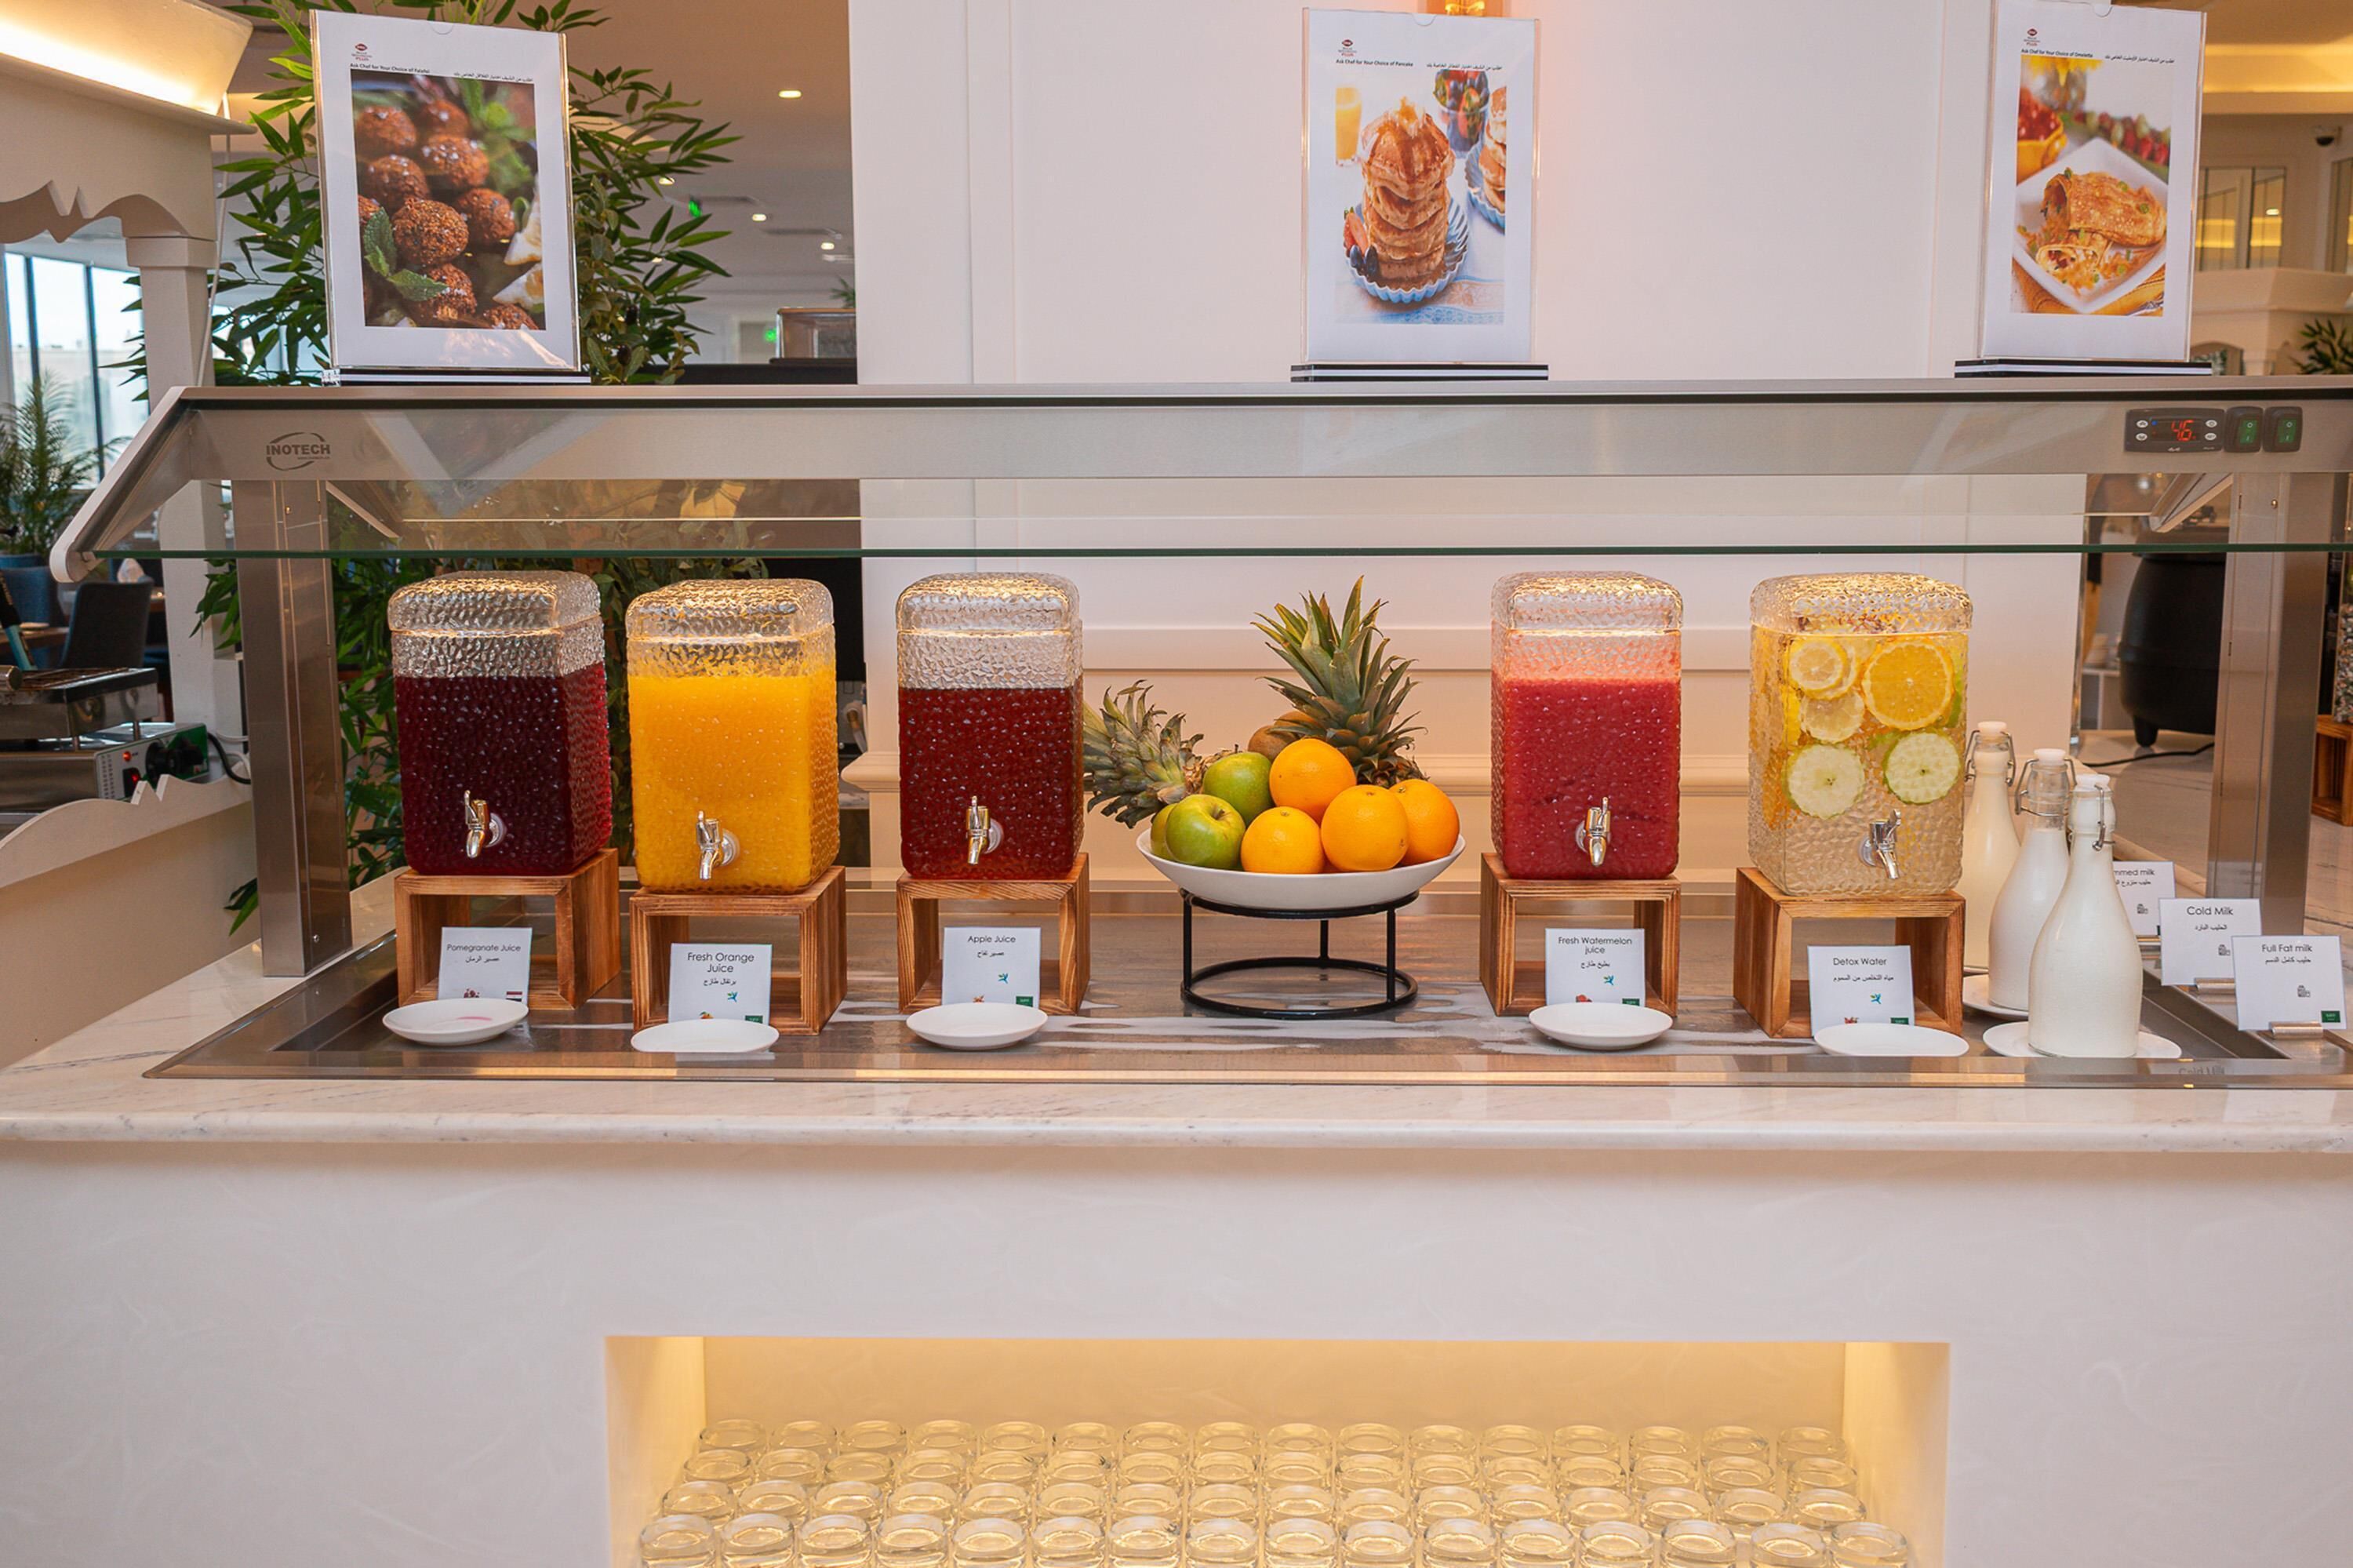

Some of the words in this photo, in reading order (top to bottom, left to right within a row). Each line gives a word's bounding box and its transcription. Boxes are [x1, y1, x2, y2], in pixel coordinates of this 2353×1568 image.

[267, 445, 330, 455] INOTECH
[2187, 906, 2212, 916] Cold
[2214, 907, 2234, 916] Milk
[446, 944, 499, 952] Pomegranate
[1585, 946, 1605, 955] juice
[2262, 944, 2276, 953] Full
[2278, 944, 2293, 953] Fat
[687, 952, 713, 962] Fresh
[715, 952, 755, 963] Orange
[707, 963, 734, 973] Juice
